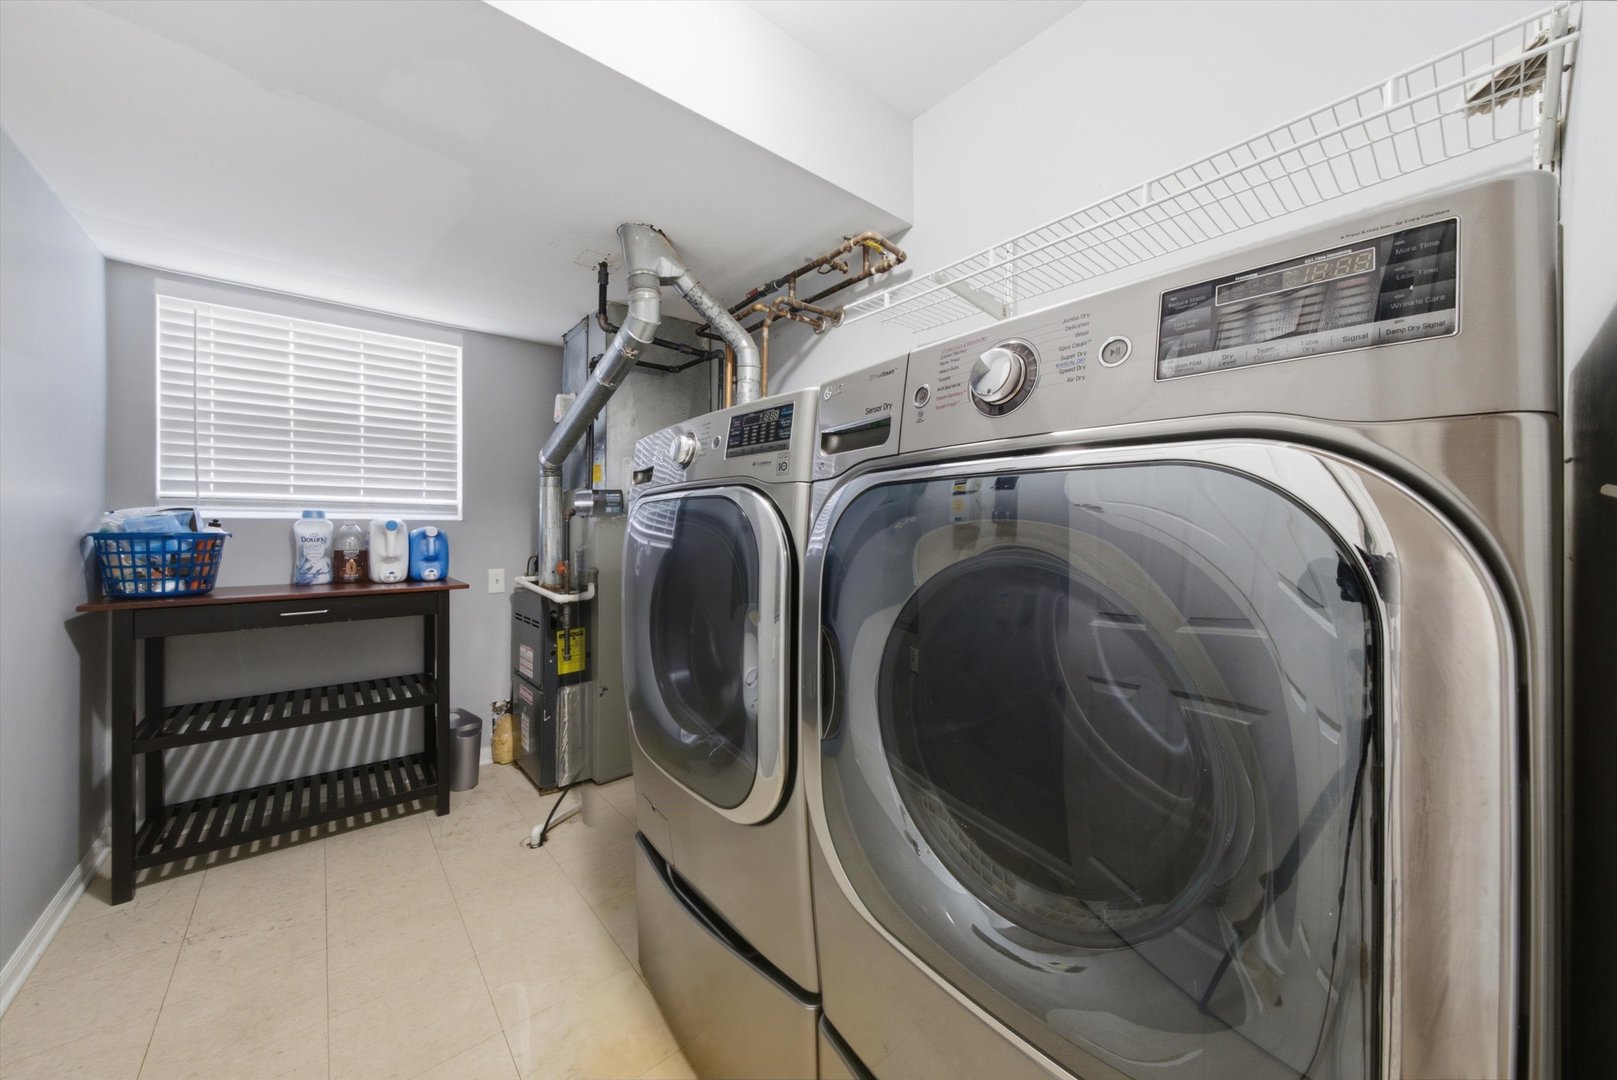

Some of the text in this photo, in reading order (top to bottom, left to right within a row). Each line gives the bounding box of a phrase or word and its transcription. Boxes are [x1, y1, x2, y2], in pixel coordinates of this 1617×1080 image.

[1395, 240, 1440, 255] More Time
[1396, 267, 1439, 281] Less Time
[1390, 294, 1446, 310] Wrinkle Care
[1386, 320, 1446, 336] Damp Dry Signal
[1074, 330, 1089, 338] Wool
[1342, 332, 1369, 343] Signal
[1058, 344, 1071, 352] Spot
[1060, 353, 1076, 361] Super
[1221, 353, 1234, 361] Dry
[1218, 359, 1237, 367] Level
[1058, 366, 1076, 375] Speed
[865, 402, 893, 415] Sensor Dry
[300, 536, 327, 544] Downy
